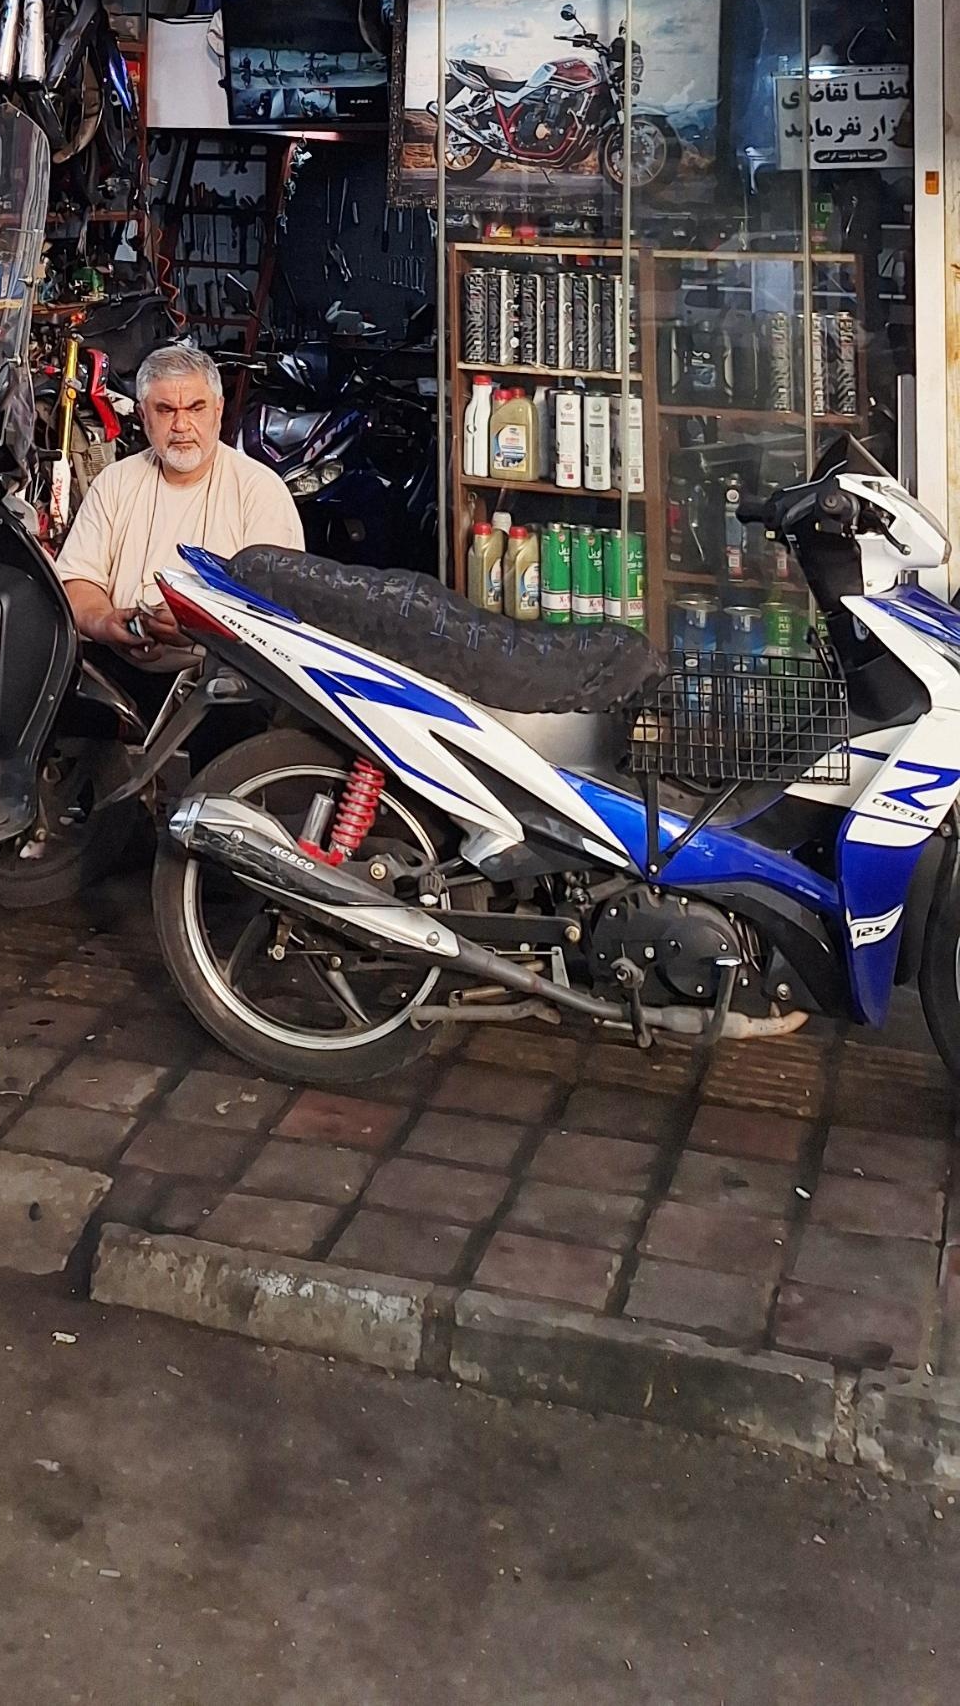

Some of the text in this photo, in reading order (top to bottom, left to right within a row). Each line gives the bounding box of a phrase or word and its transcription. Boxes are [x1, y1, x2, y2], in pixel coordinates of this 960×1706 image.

[781, 80, 849, 110] تقاضی
[221, 614, 292, 662] CRYSTAL 125
[872, 797, 932, 825] CRYSTAL
[856, 924, 887, 939] 125
